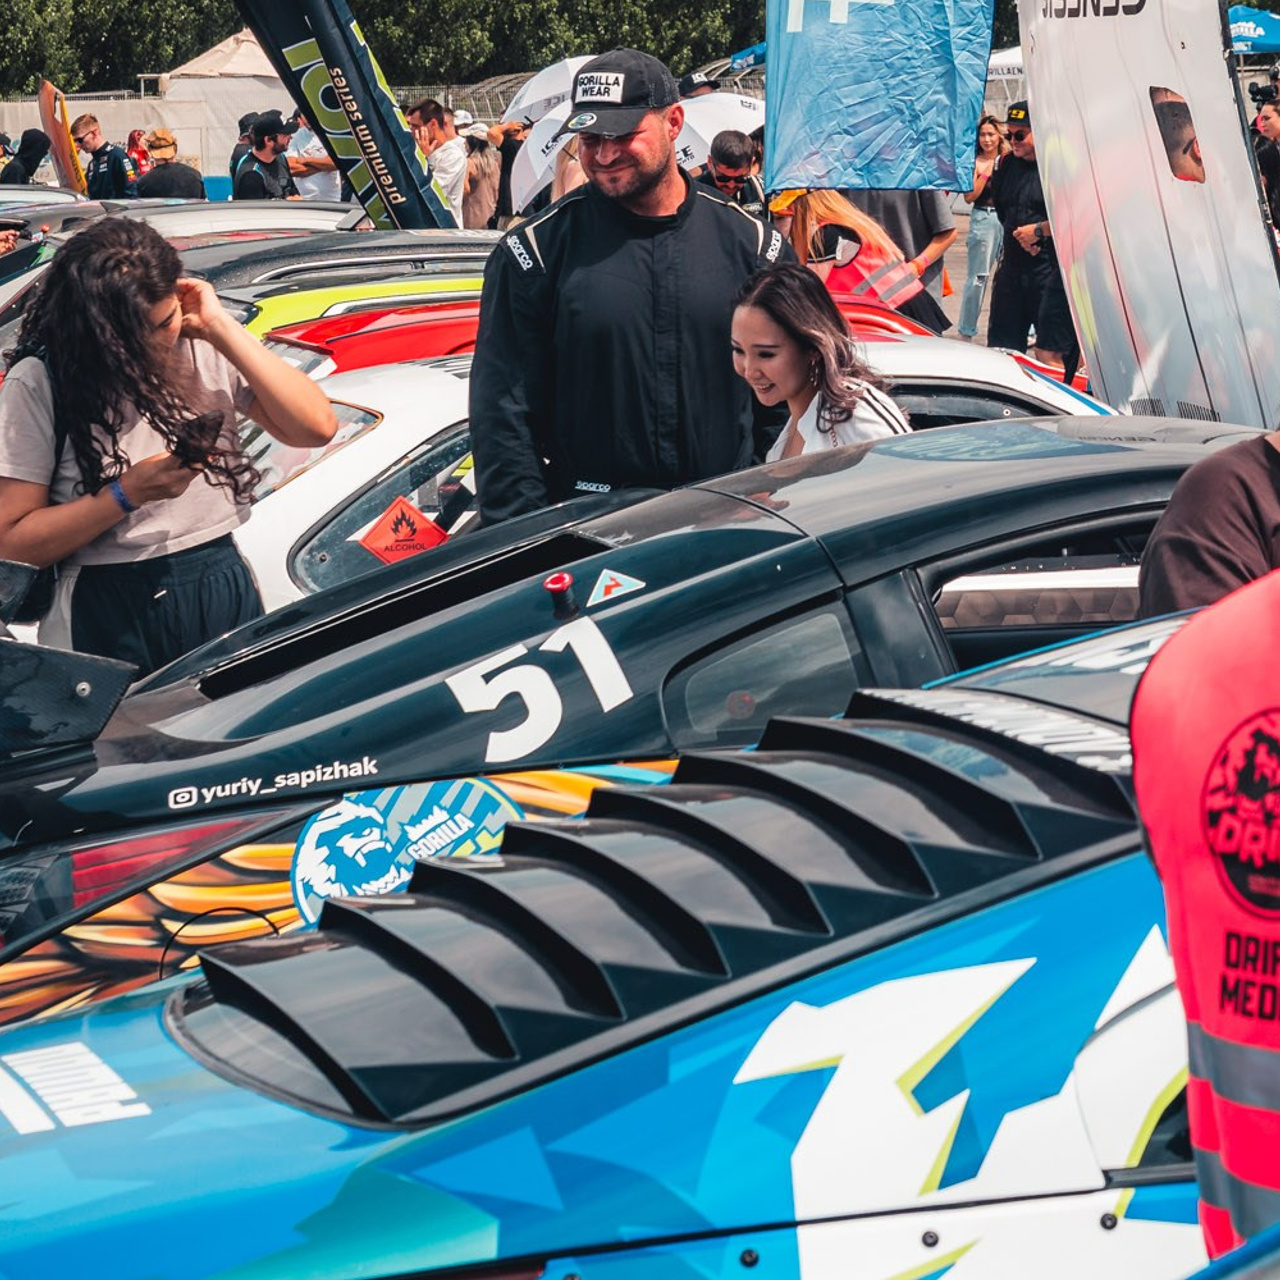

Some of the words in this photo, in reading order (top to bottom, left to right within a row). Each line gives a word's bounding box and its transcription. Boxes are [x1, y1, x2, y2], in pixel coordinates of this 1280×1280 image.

[330, 66, 363, 121] series
[578, 75, 621, 87] GORILLA
[582, 86, 611, 97] WEAR
[355, 125, 407, 205] premium
[507, 234, 534, 271] sparco
[575, 480, 612, 493] sparco
[384, 542, 426, 552] ALCOHOL
[444, 615, 634, 763] 51
[200, 756, 379, 803] yuriy_sapizhak
[407, 812, 476, 860] GORILLA
